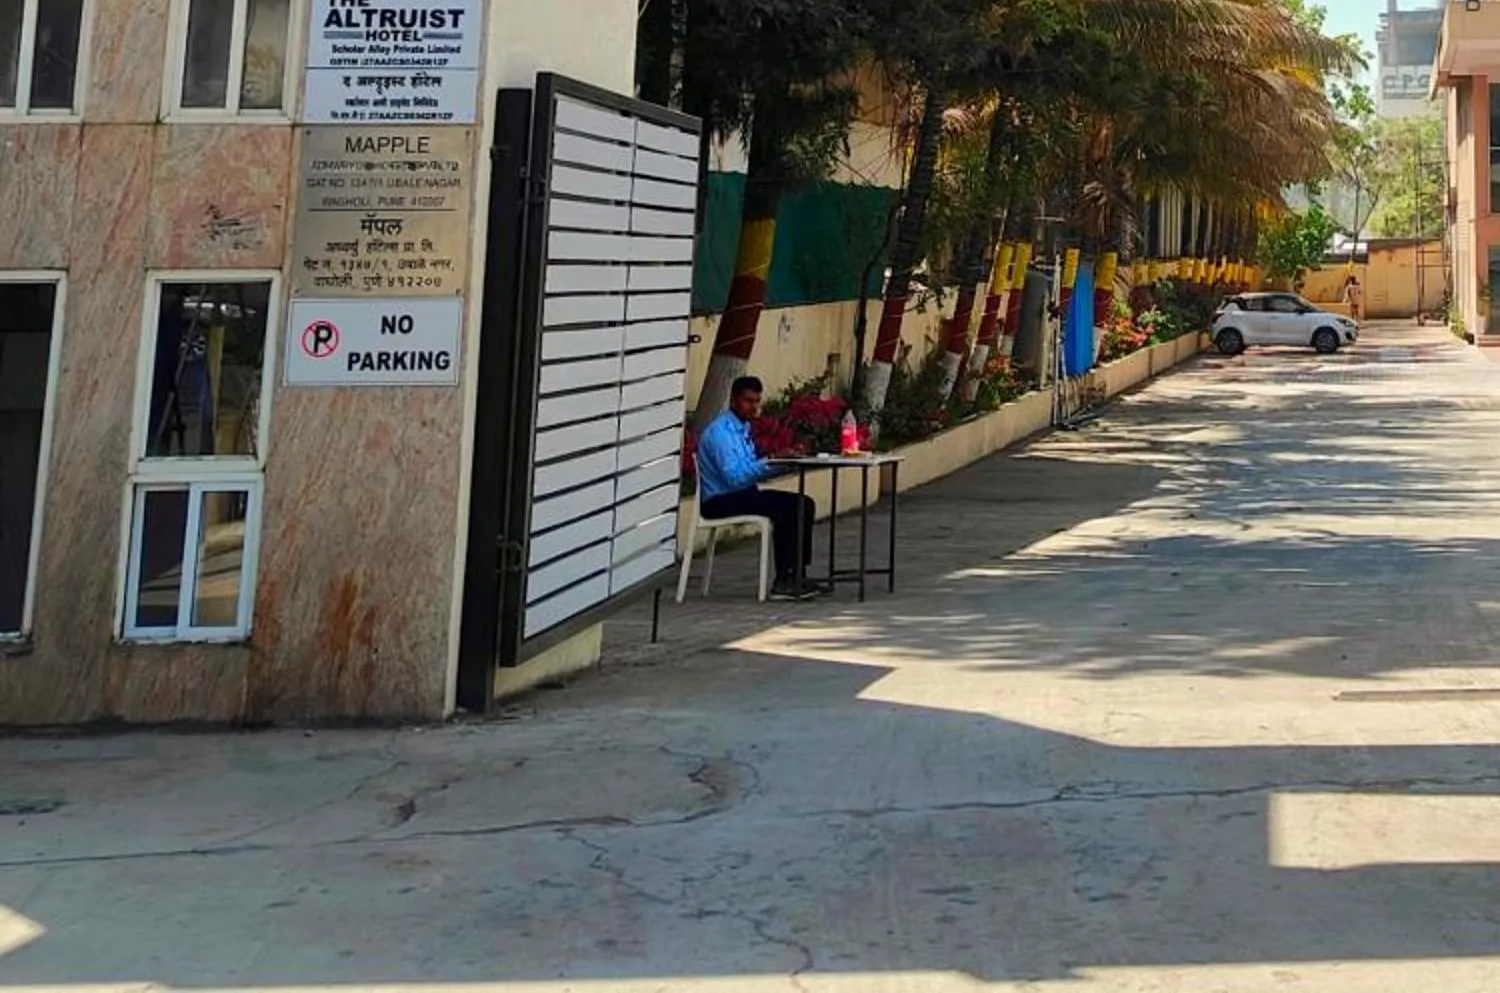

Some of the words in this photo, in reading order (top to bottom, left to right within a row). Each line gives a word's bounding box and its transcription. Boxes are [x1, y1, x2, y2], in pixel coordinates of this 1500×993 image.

[324, 9, 465, 28] ALTRUIST
[365, 30, 423, 42] HOTEL
[331, 44, 366, 54] Scholar
[394, 44, 425, 54] Private
[428, 44, 461, 54] Limited
[345, 136, 431, 154] MAPPLE
[378, 196, 406, 206] PUNE
[360, 213, 403, 235] मॅपल
[381, 314, 415, 335] NO
[313, 324, 333, 354] P
[347, 350, 451, 371] PARKING
